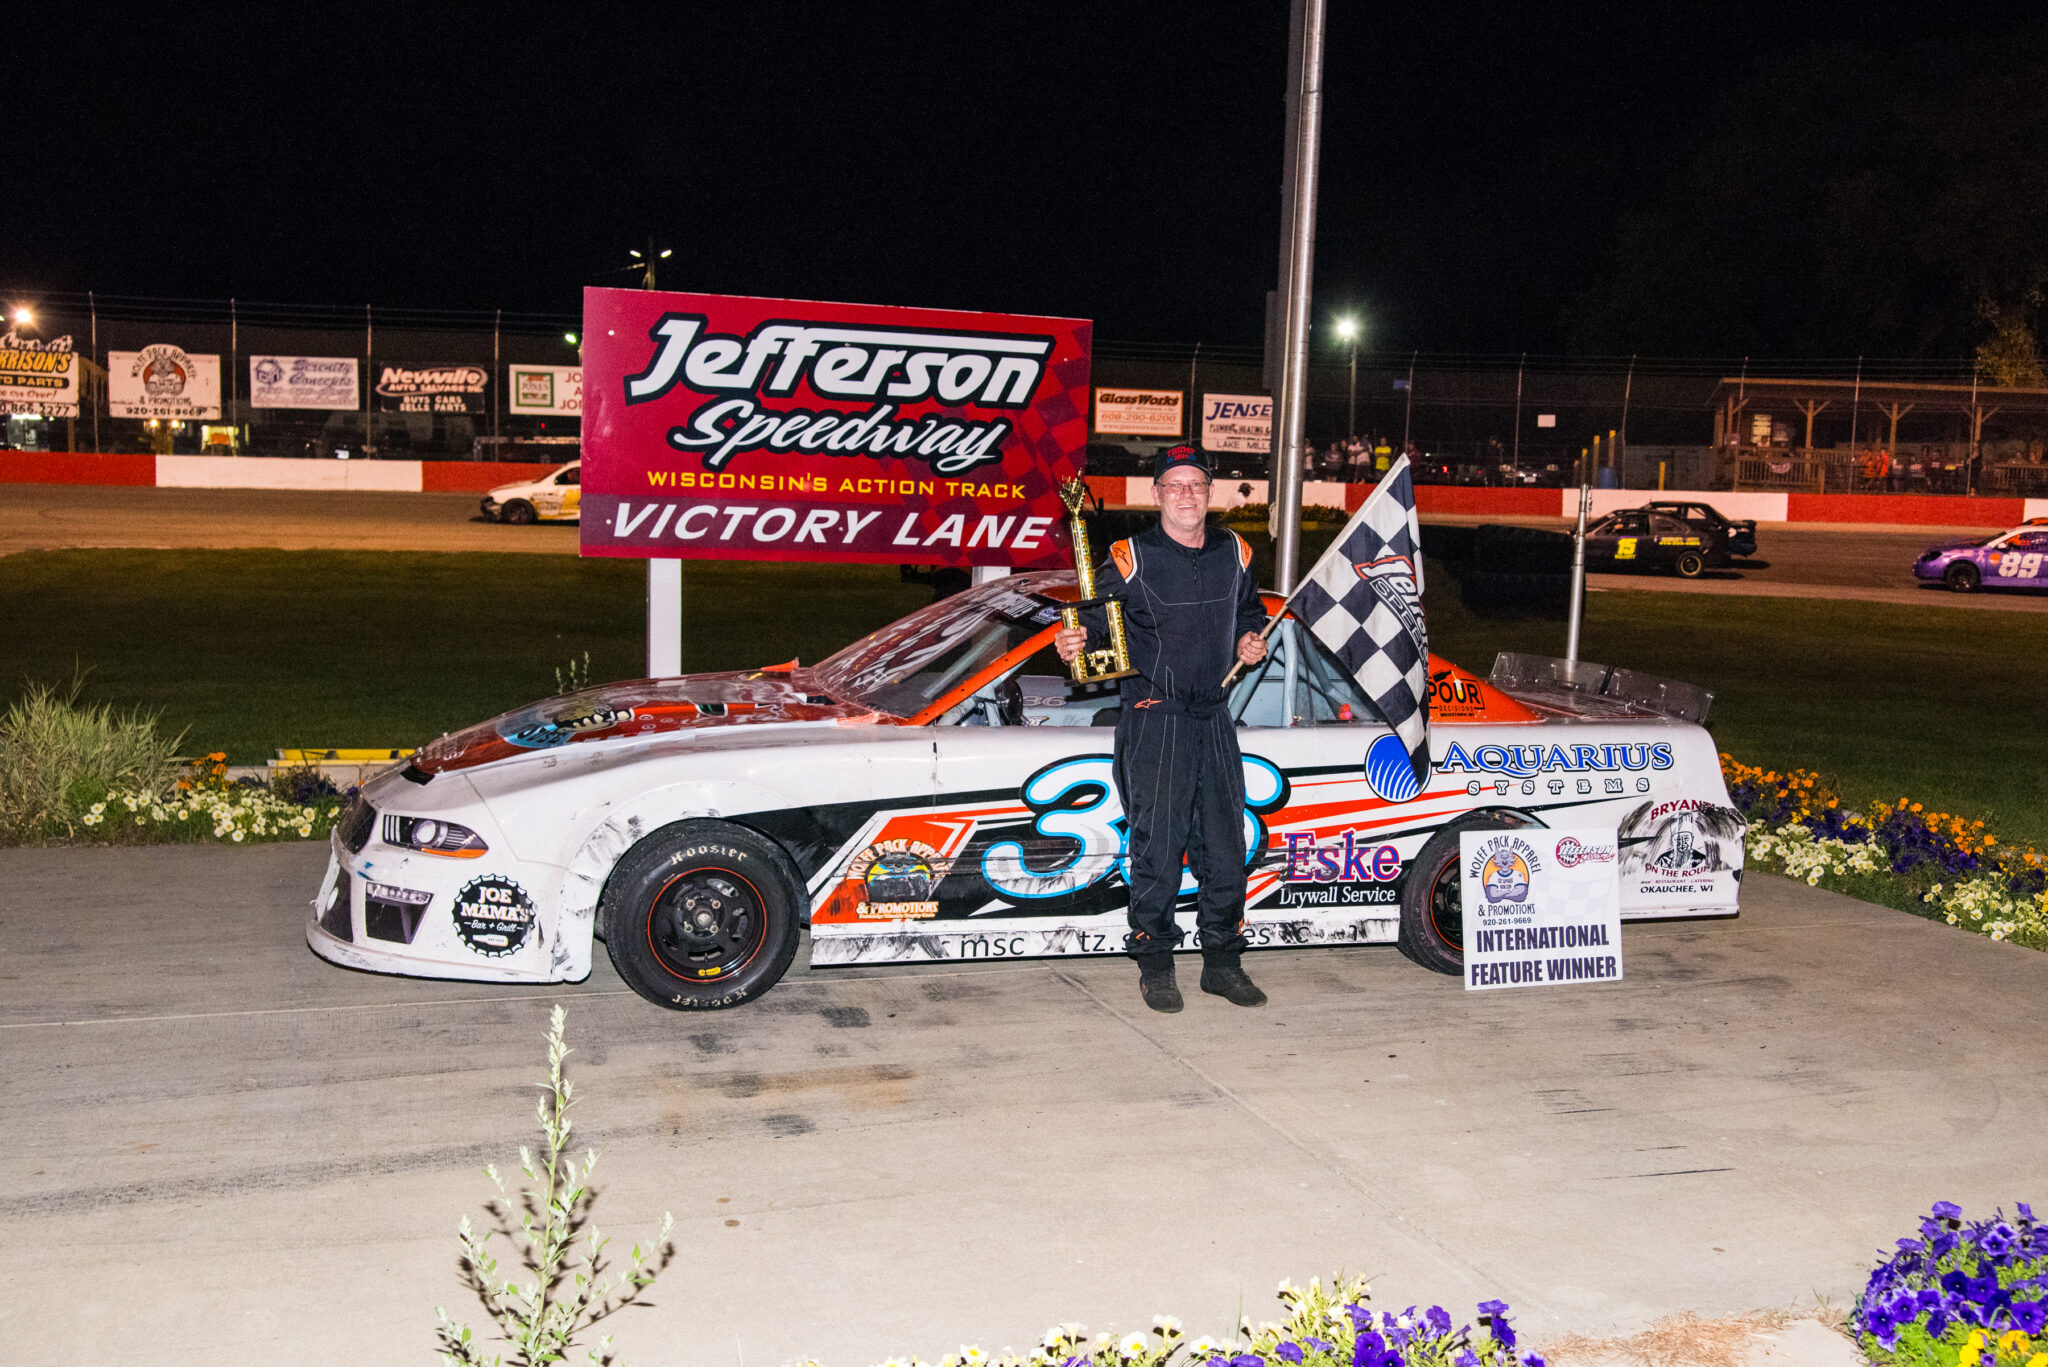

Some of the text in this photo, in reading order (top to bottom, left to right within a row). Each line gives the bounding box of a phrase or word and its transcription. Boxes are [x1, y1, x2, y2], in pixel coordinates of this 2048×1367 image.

[628, 315, 1054, 407] Jefferson
[17, 376, 63, 388] PARTS
[380, 367, 481, 384] Newville
[420, 384, 465, 392] SALVAGE
[400, 403, 467, 412] SELLS PARTS
[403, 395, 462, 404] BUYS CARS
[1099, 393, 1179, 406] GlassWorks
[673, 400, 1007, 473] Speedway
[1217, 441, 1240, 449] LAKE
[1167, 446, 1195, 457] TRUMP
[647, 471, 1026, 500] WISCONSIN'S ACTION TRACK
[612, 502, 1054, 550] VICTORY LANE
[1998, 552, 2043, 578] 89
[1429, 681, 1481, 704] POUR
[1437, 741, 1674, 778] AQUARIUS
[1467, 778, 1650, 796] SYSTEMS
[875, 838, 910, 856] PACK
[1283, 828, 1401, 882] Eske
[1470, 835, 1542, 879] WOLFF PACK APPAREL
[1661, 868, 1679, 878] THE
[478, 886, 512, 904] JOE
[1279, 886, 1396, 908] Drywall Service
[1640, 884, 1714, 894] OKAUCHEE, WI
[460, 902, 530, 922] MAMA'S
[856, 901, 939, 915] & PROMOTIONS
[1477, 903, 1536, 917] & PROMOTIONS
[471, 920, 486, 930] Bar
[496, 922, 518, 932] Grill
[1482, 917, 1532, 926] 920-261-9669
[1476, 924, 1609, 953] INTERNATIONAL
[1471, 955, 1617, 986] FEATURE WINNER
